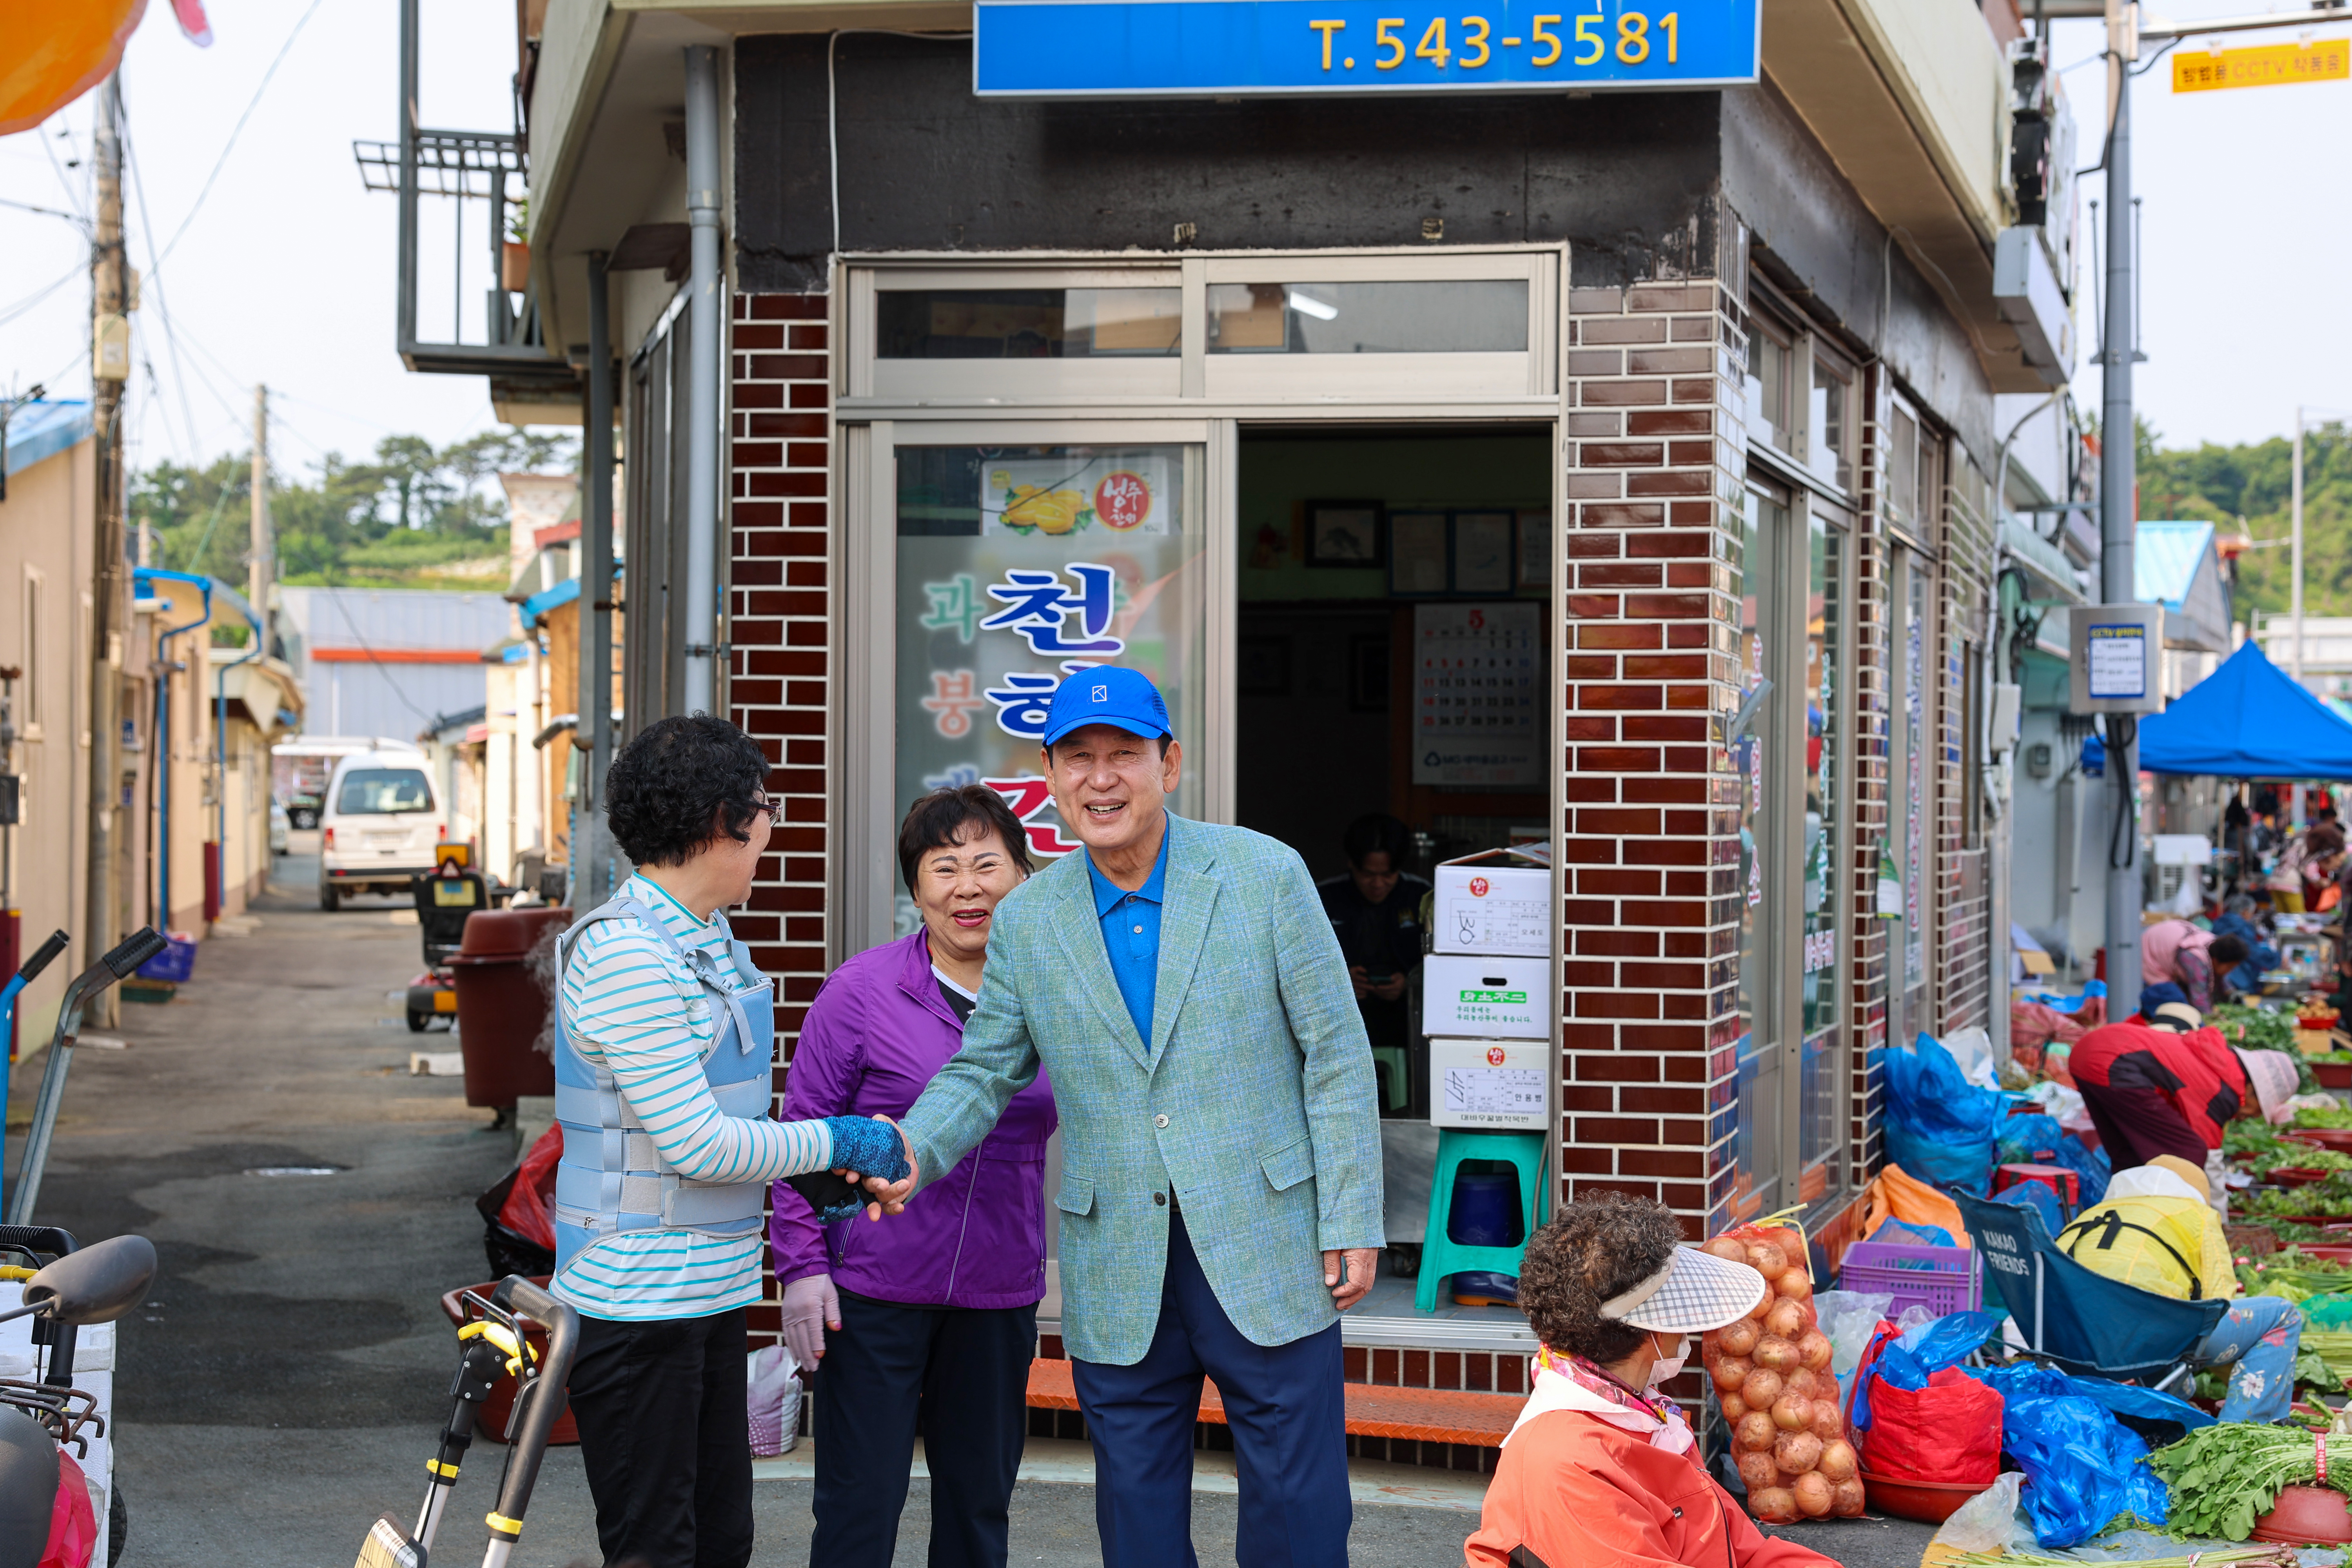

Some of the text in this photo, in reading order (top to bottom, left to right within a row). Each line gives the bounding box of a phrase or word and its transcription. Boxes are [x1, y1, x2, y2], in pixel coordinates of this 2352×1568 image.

[1309, 12, 1678, 71] T. 543-5581
[1103, 477, 1143, 512] 성주
[1468, 609, 1485, 630] 5
[1462, 992, 1526, 1002] 身土不二
[1982, 1229, 2017, 1254] KAKAO
[1987, 1250, 2030, 1276] FRIENDS
